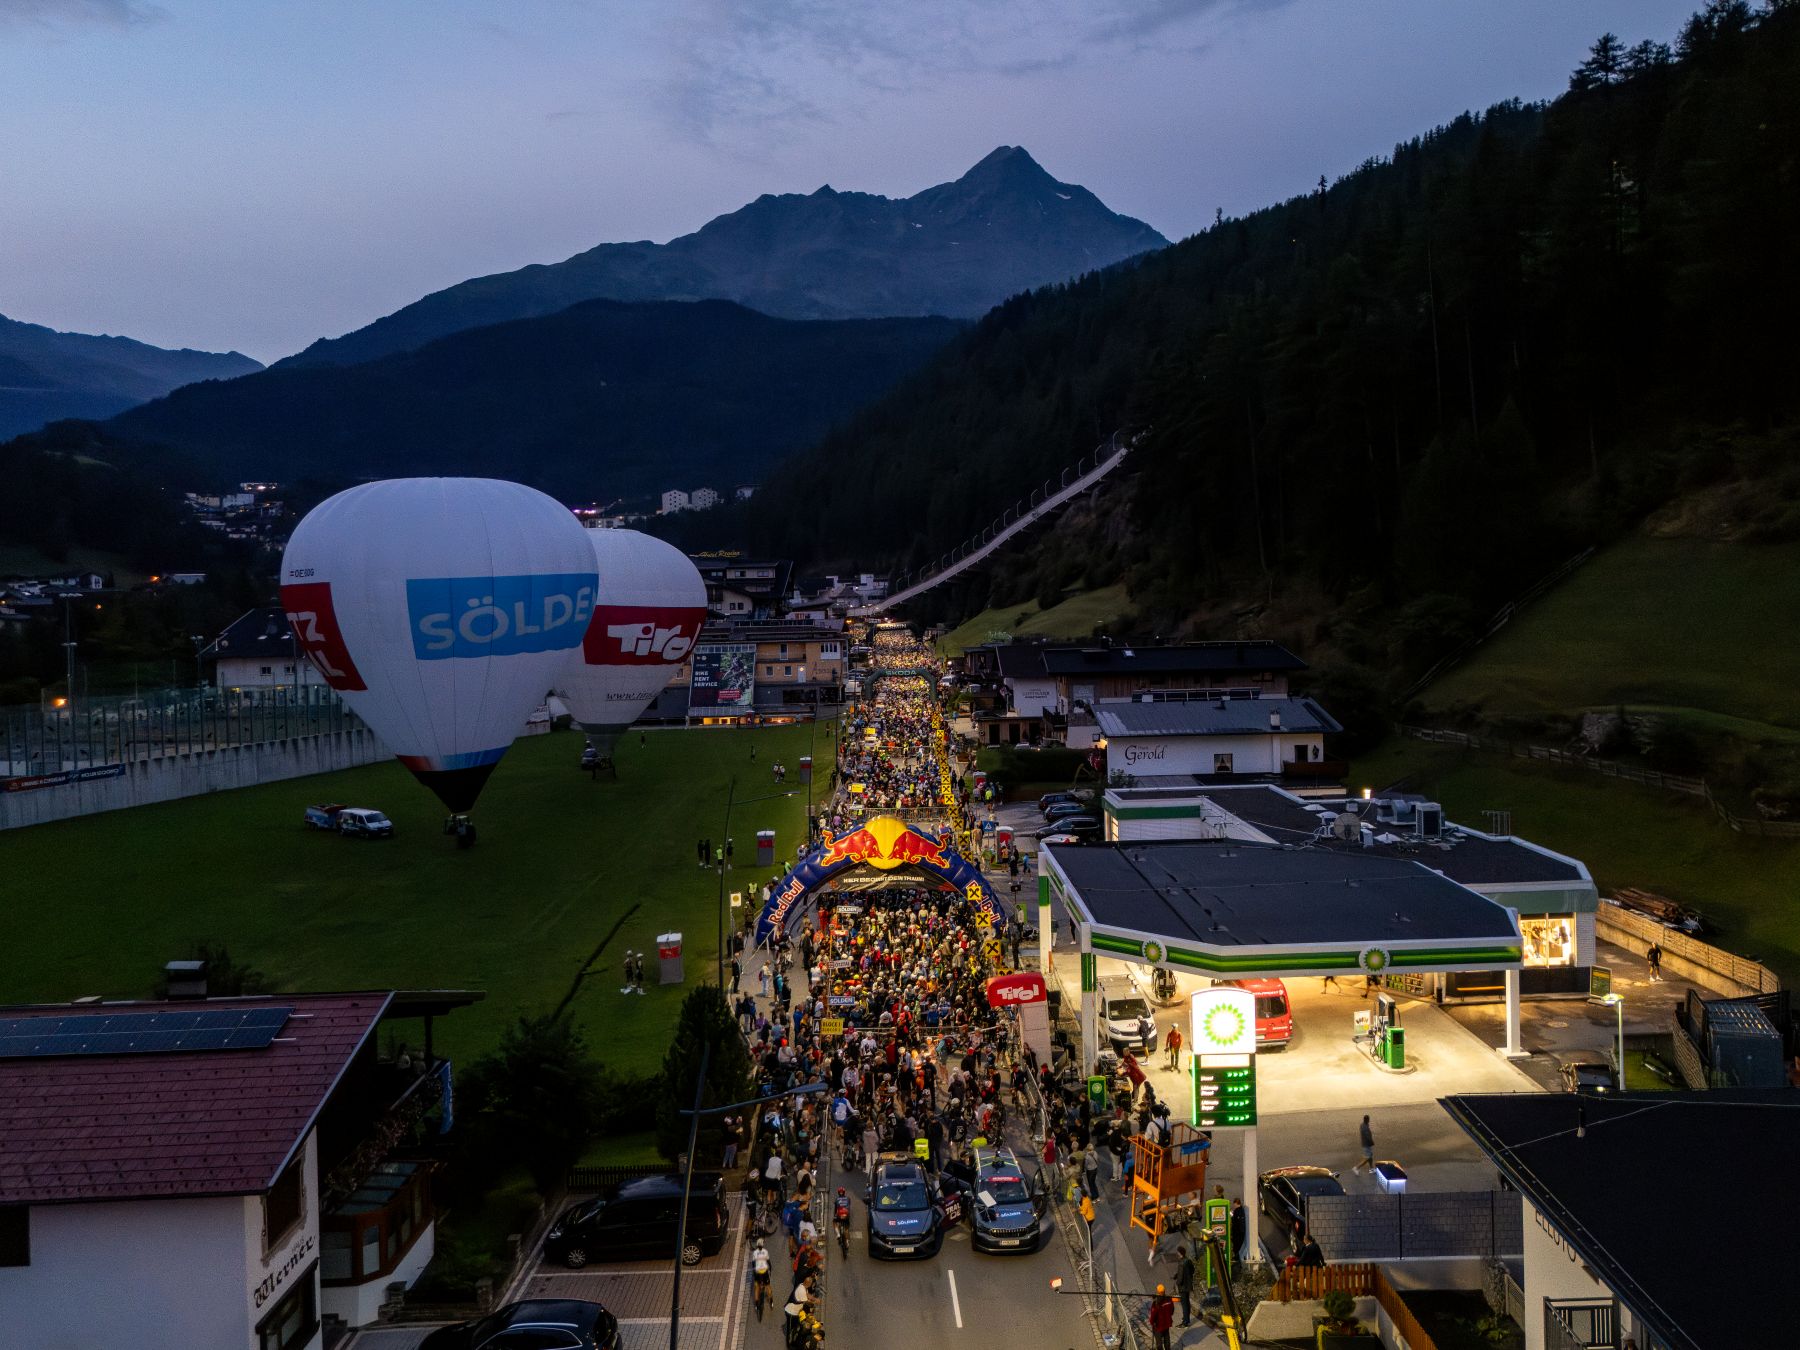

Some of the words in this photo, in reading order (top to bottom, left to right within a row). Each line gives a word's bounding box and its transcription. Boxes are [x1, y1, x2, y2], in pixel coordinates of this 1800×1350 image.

[419, 587, 598, 650] SÖLDE
[607, 622, 702, 661] Tirol
[1125, 745, 1168, 765] Gerold
[768, 898, 789, 924] Red
[782, 878, 805, 904] Bull
[996, 984, 1040, 1001] Tirol
